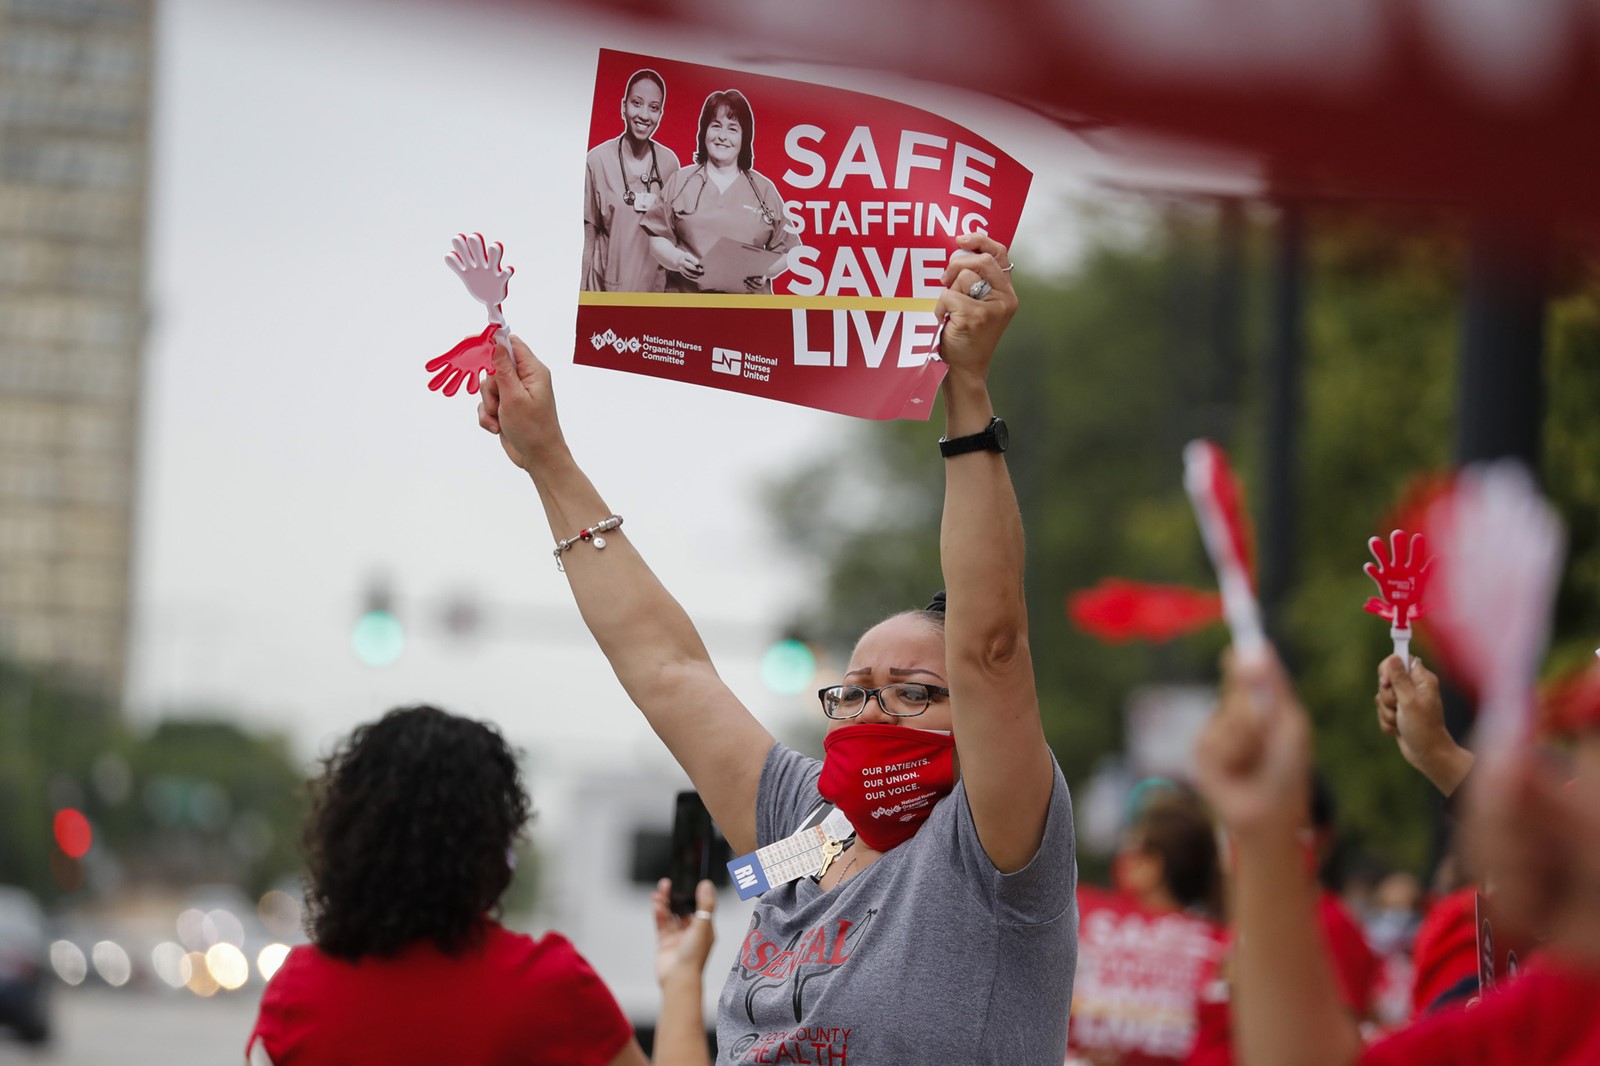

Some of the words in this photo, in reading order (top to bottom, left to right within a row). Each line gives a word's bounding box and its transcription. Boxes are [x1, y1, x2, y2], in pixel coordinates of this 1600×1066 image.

[782, 123, 996, 210] SAFE
[782, 200, 989, 238] STAFFING
[786, 246, 975, 298] SAVE
[643, 334, 676, 347] National
[676, 340, 702, 352] Nurses
[791, 309, 942, 368] LIVE
[642, 343, 685, 358] Organizing
[642, 351, 685, 366] Committee
[744, 353, 778, 366] National
[743, 370, 770, 382] United
[744, 362, 771, 374] Nurses
[862, 766, 883, 776] OUR
[885, 758, 931, 773] PATIENTS.
[863, 779, 884, 788] OUR
[885, 771, 920, 785] UNION.
[865, 791, 886, 801] OUR
[887, 783, 920, 796] VOICE.
[734, 863, 758, 890] RN
[743, 1041, 848, 1066] HEALTH
